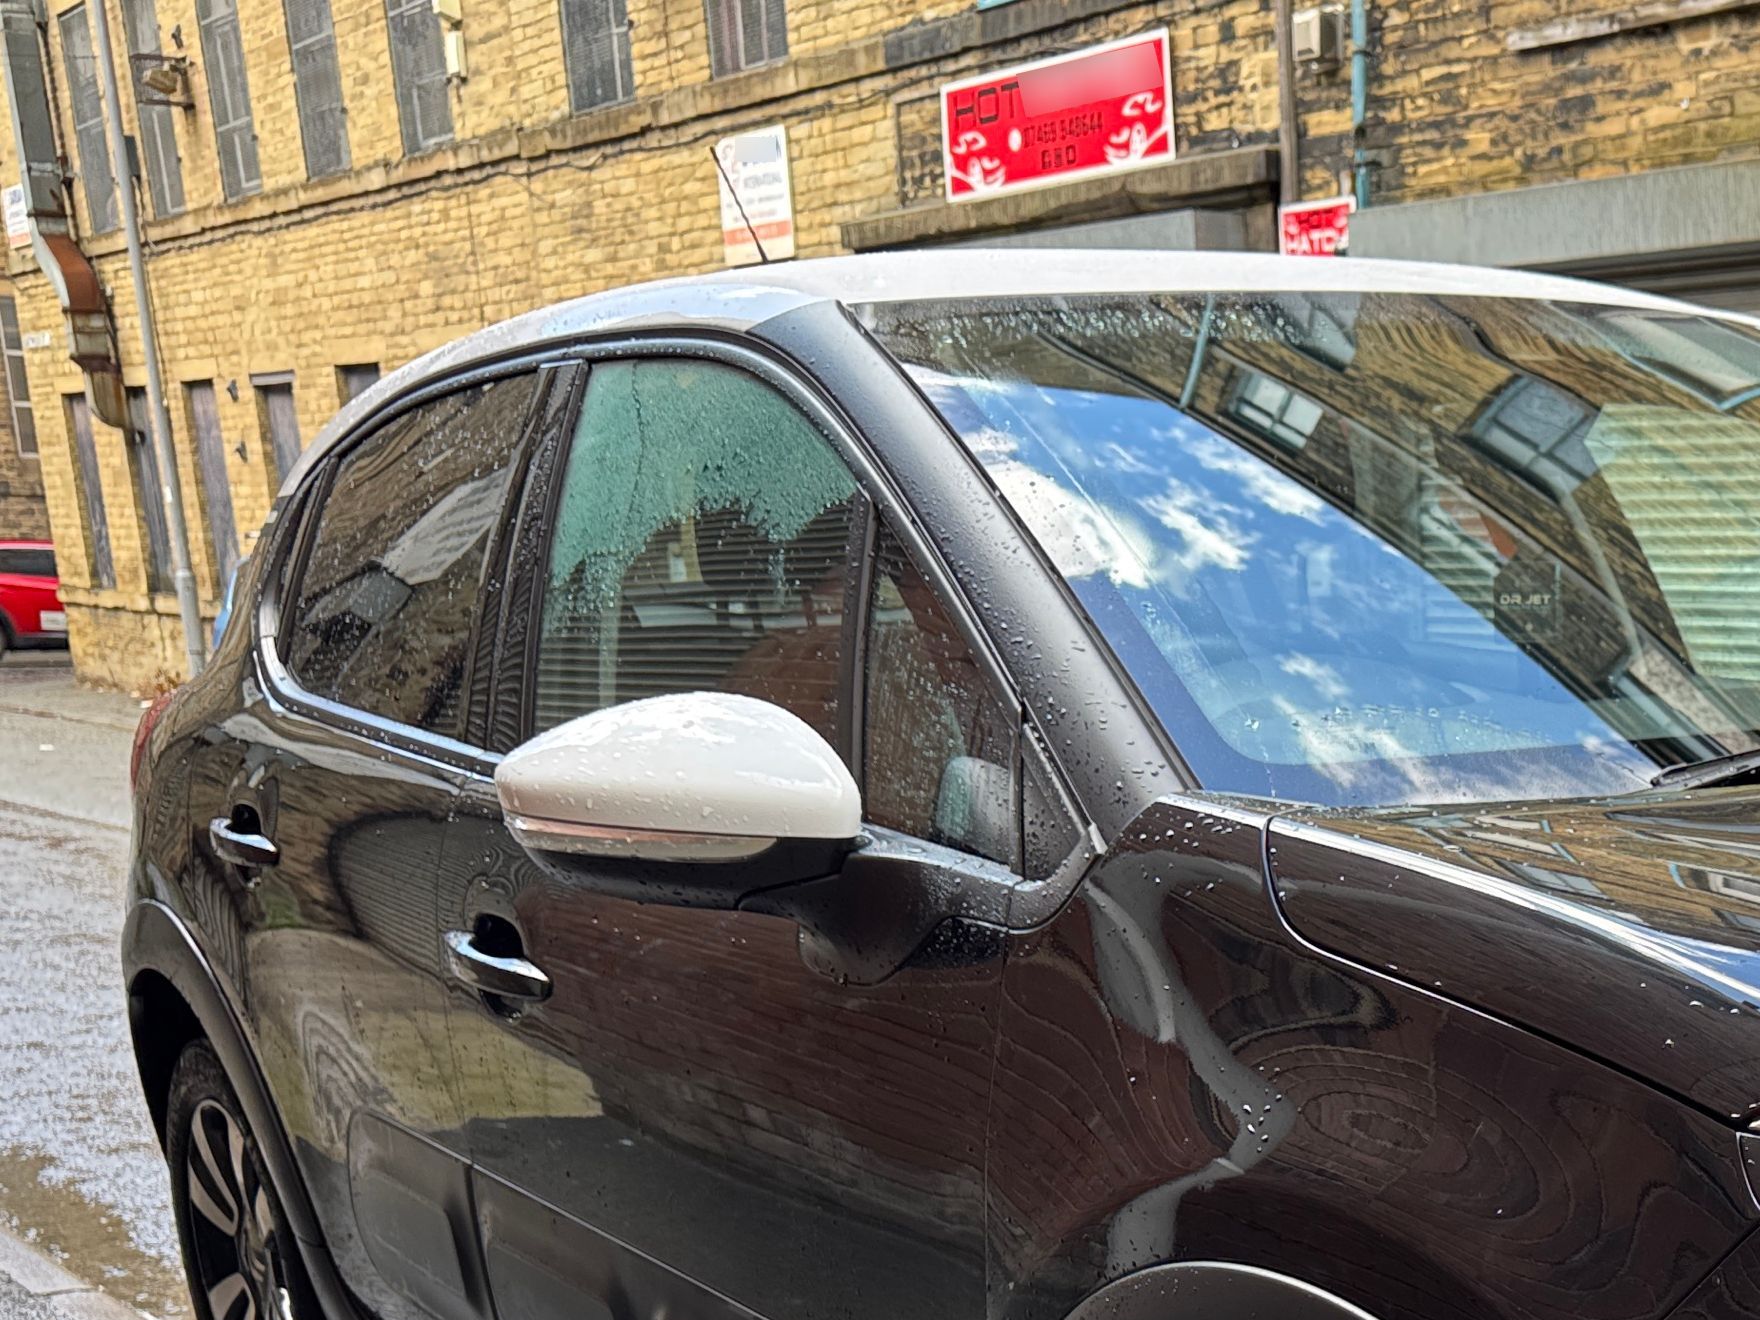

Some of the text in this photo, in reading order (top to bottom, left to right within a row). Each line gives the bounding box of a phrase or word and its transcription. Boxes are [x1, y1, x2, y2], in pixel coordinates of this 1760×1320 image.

[953, 81, 1020, 129] HOT
[1500, 594, 1552, 605] DR JET
